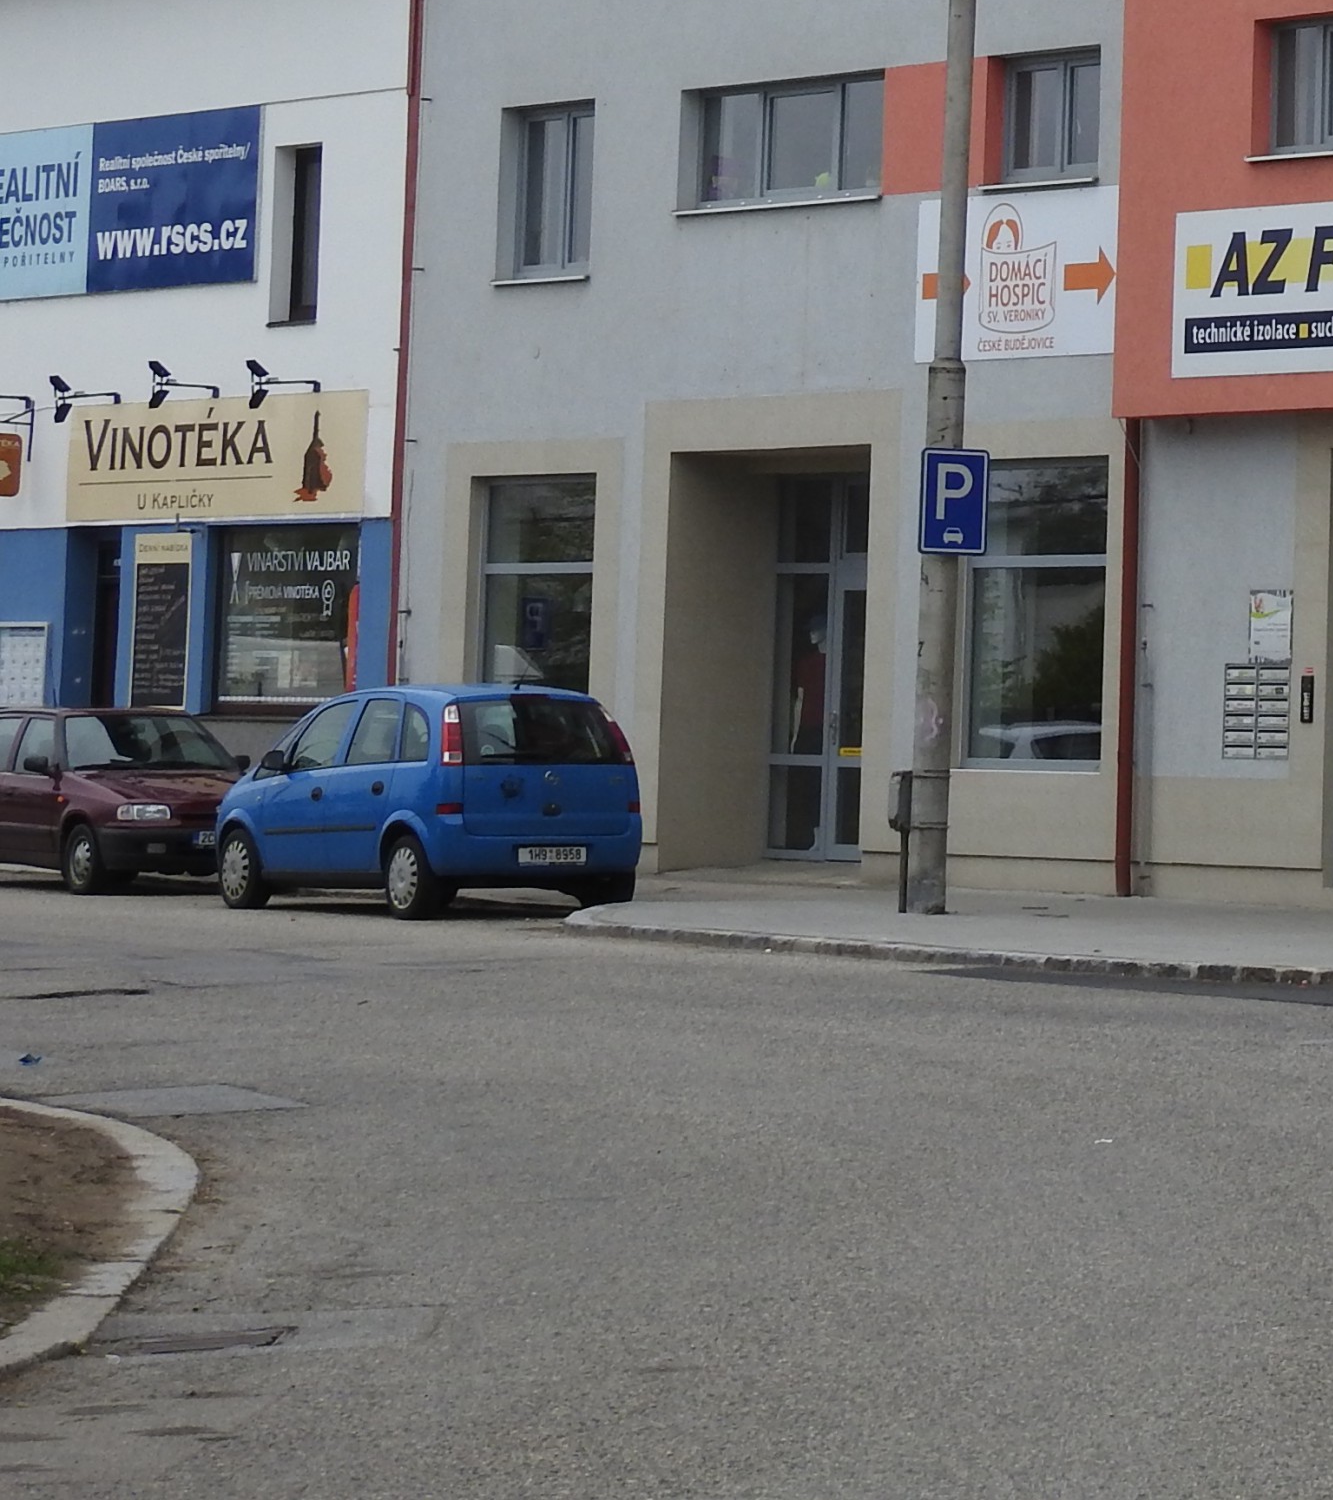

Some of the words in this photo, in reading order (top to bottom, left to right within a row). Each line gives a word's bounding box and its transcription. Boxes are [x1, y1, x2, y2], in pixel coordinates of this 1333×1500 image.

[99, 154, 131, 171] Realitní
[177, 145, 203, 163] České
[97, 219, 248, 261] www.rscs.cz
[989, 252, 1047, 282] DOMÁCÍ
[1210, 228, 1293, 298] AZ
[988, 282, 1046, 307] HOSPIC
[987, 310, 1000, 324] SV.
[1003, 308, 1046, 322] VERONIKY
[977, 337, 1002, 352] ČESKÉ
[1004, 336, 1055, 351] BUDĚJOVICE
[1192, 321, 1251, 344] technické
[1253, 320, 1297, 342] izolace
[137, 494, 146, 510] U
[935, 462, 973, 520] P
[247, 546, 305, 572] VINAŘSTVÍ
[306, 550, 350, 571] VAJBAR
[283, 583, 320, 599] VINOTÉKA
